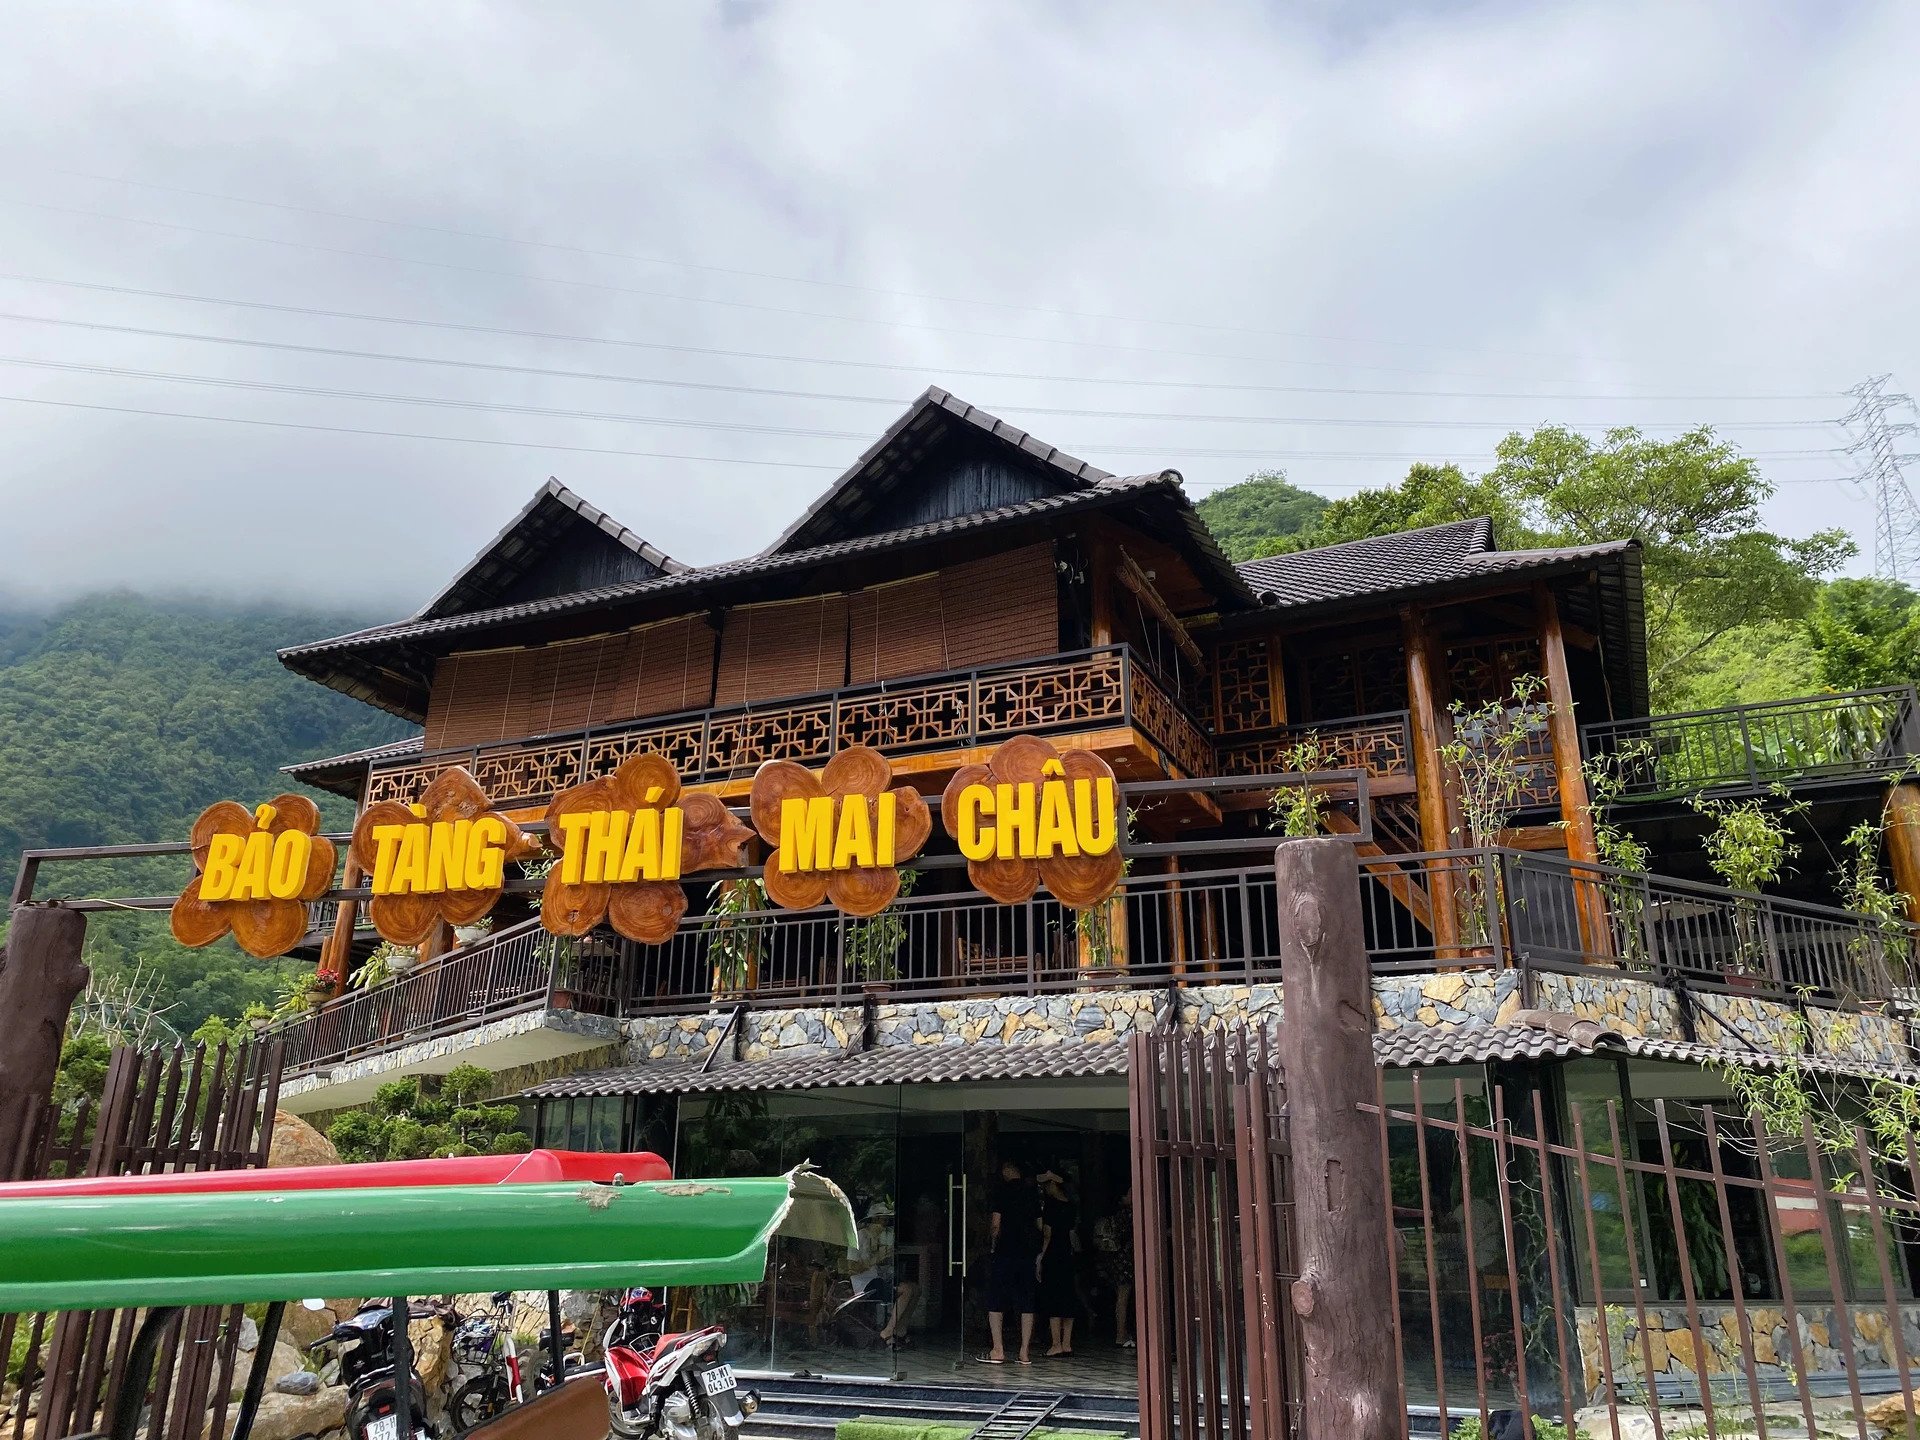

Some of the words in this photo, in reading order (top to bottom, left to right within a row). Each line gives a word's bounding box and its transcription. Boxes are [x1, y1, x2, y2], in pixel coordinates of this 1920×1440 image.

[199, 804, 311, 900] BẢO
[371, 804, 505, 894] TÀNG
[559, 787, 683, 885] THÁI
[779, 792, 896, 872] MAI
[957, 759, 1115, 861] CHÂU
